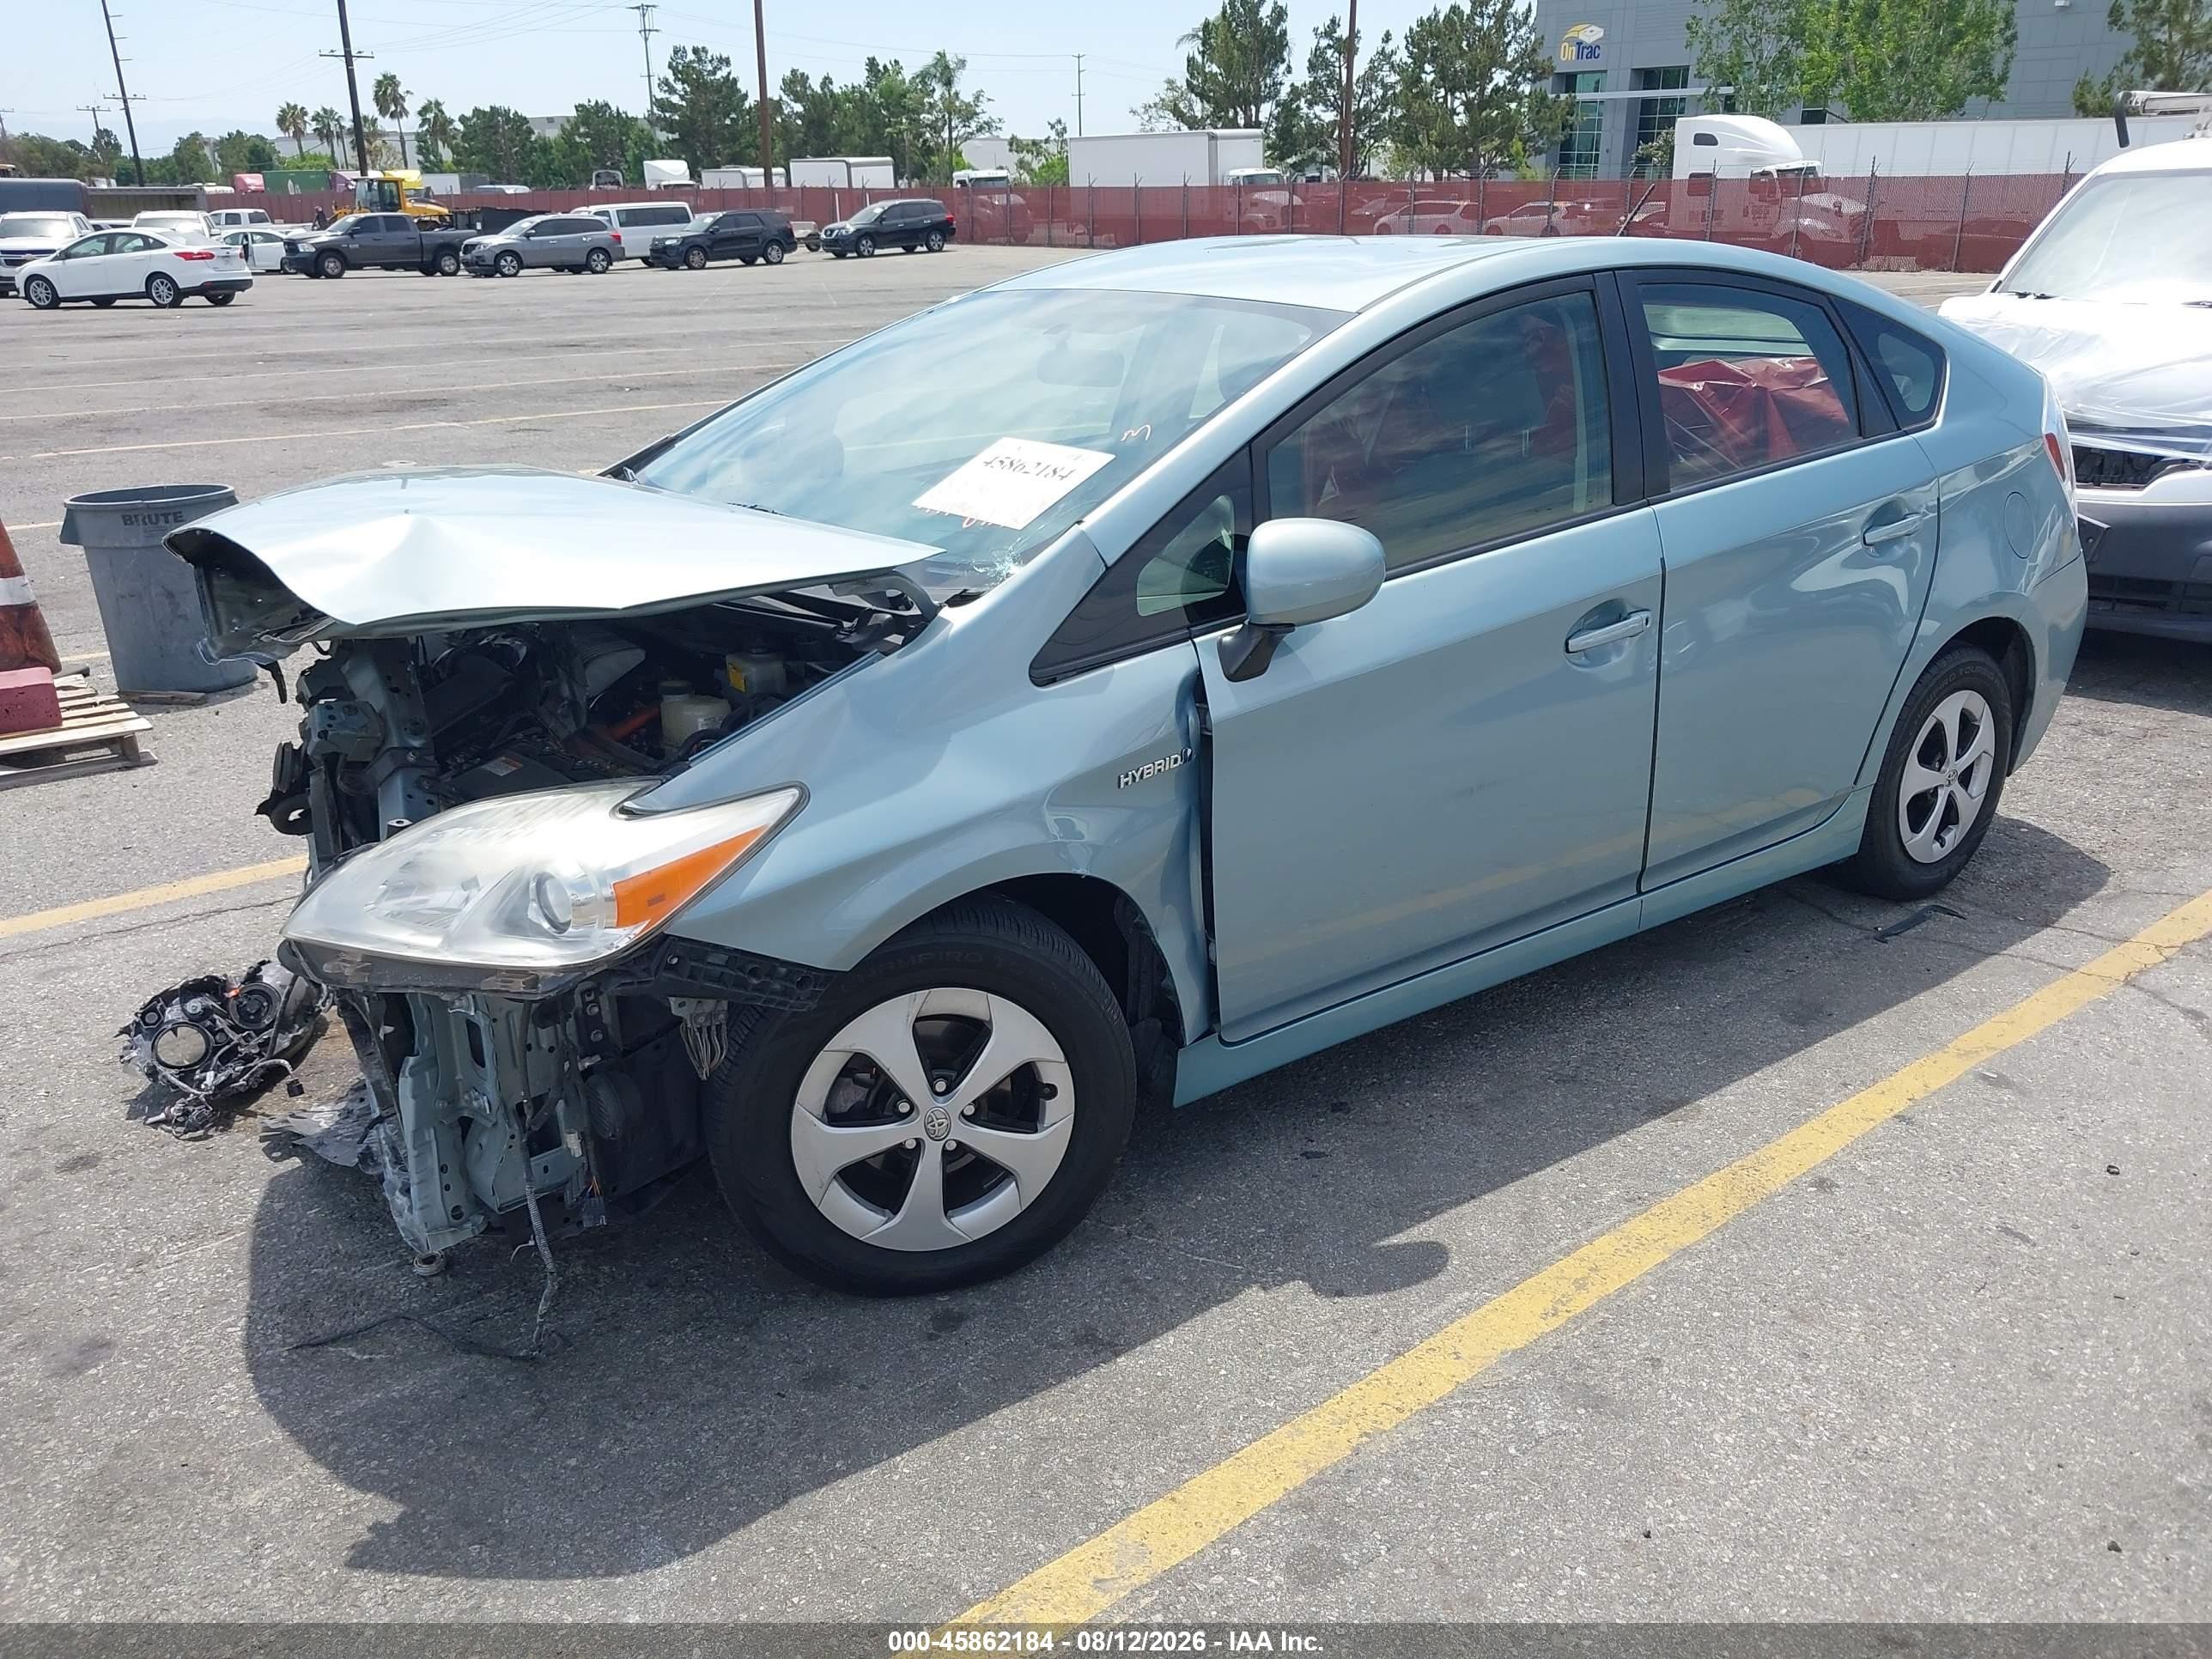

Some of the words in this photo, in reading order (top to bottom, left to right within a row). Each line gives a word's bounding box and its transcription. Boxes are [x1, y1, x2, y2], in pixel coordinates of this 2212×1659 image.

[1560, 41, 1601, 61] OnTrac
[982, 455, 1077, 481] 45862184
[121, 511, 185, 526] BRUTE
[1118, 754, 1182, 789] HYBRID
